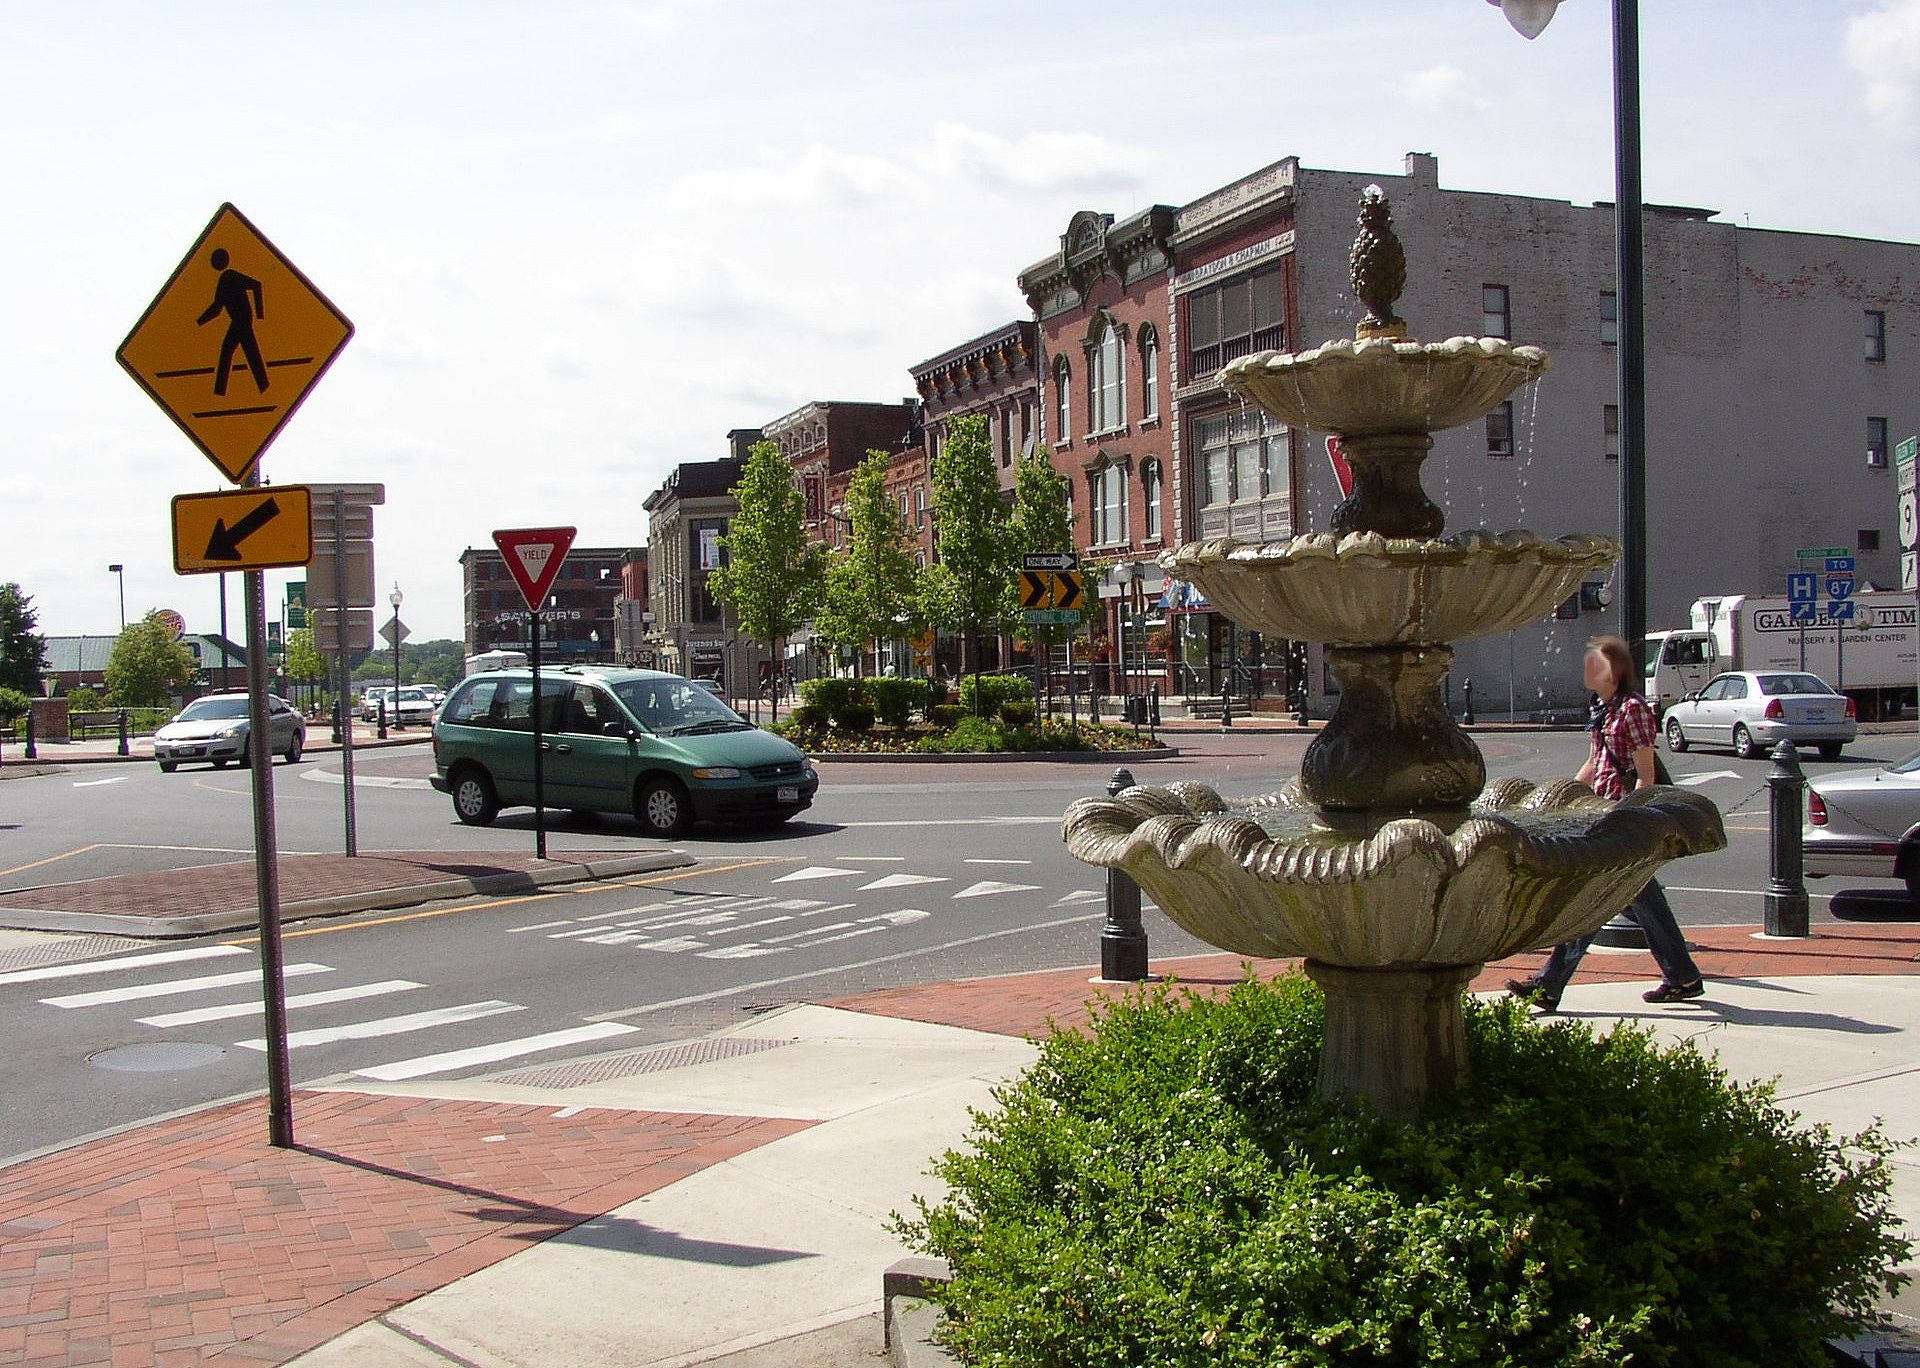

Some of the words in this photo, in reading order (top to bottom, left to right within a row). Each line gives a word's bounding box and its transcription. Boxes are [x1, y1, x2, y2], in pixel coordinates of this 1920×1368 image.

[1904, 504, 1911, 536] 9
[523, 550, 546, 560] YIELD
[1028, 558, 1043, 566] ONE
[1046, 558, 1061, 566] WAY
[1832, 560, 1847, 569] TO
[1793, 577, 1811, 598] H
[1831, 581, 1851, 595] 87
[1788, 636, 1826, 645] NUSERY
[1875, 633, 1906, 642] CENTER
